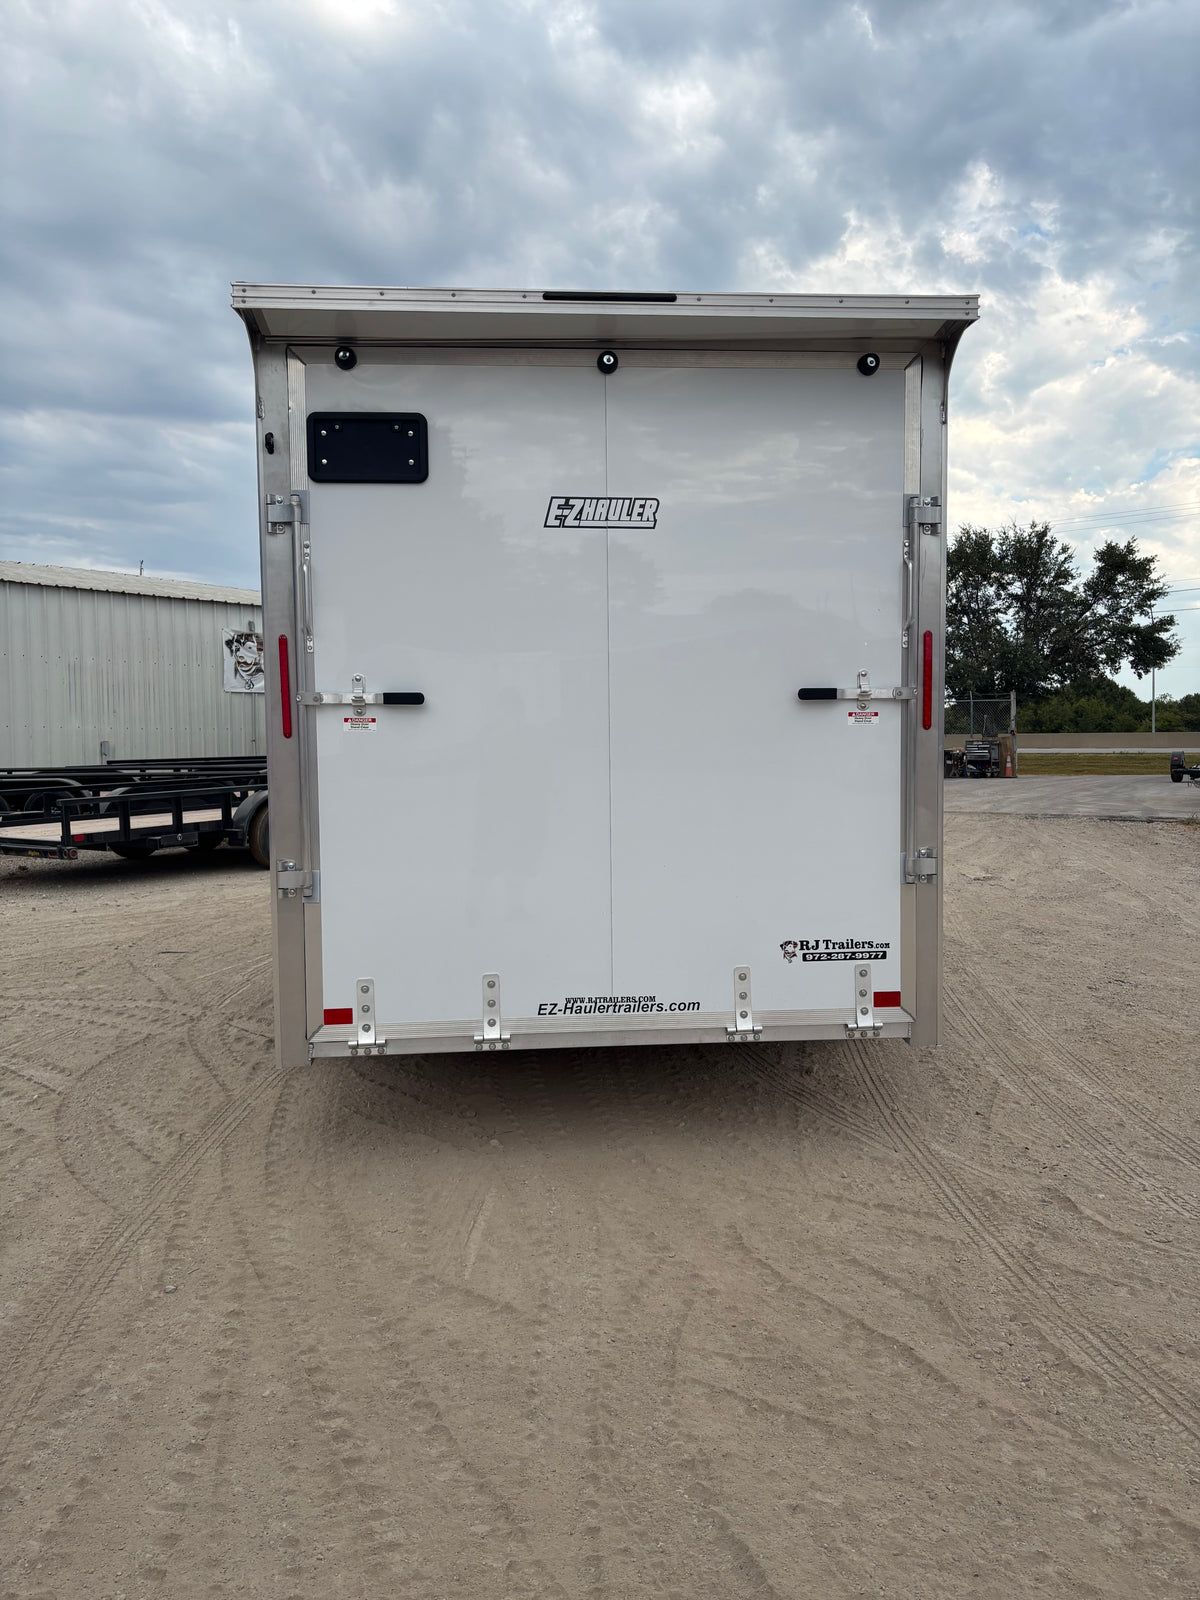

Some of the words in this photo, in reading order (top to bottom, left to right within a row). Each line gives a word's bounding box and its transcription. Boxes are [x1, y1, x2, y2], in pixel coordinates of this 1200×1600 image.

[799, 940, 820, 951] RJ
[805, 952, 884, 960] 972-287-9977
[538, 1000, 701, 1015] EZ-Haulertrailers.com
